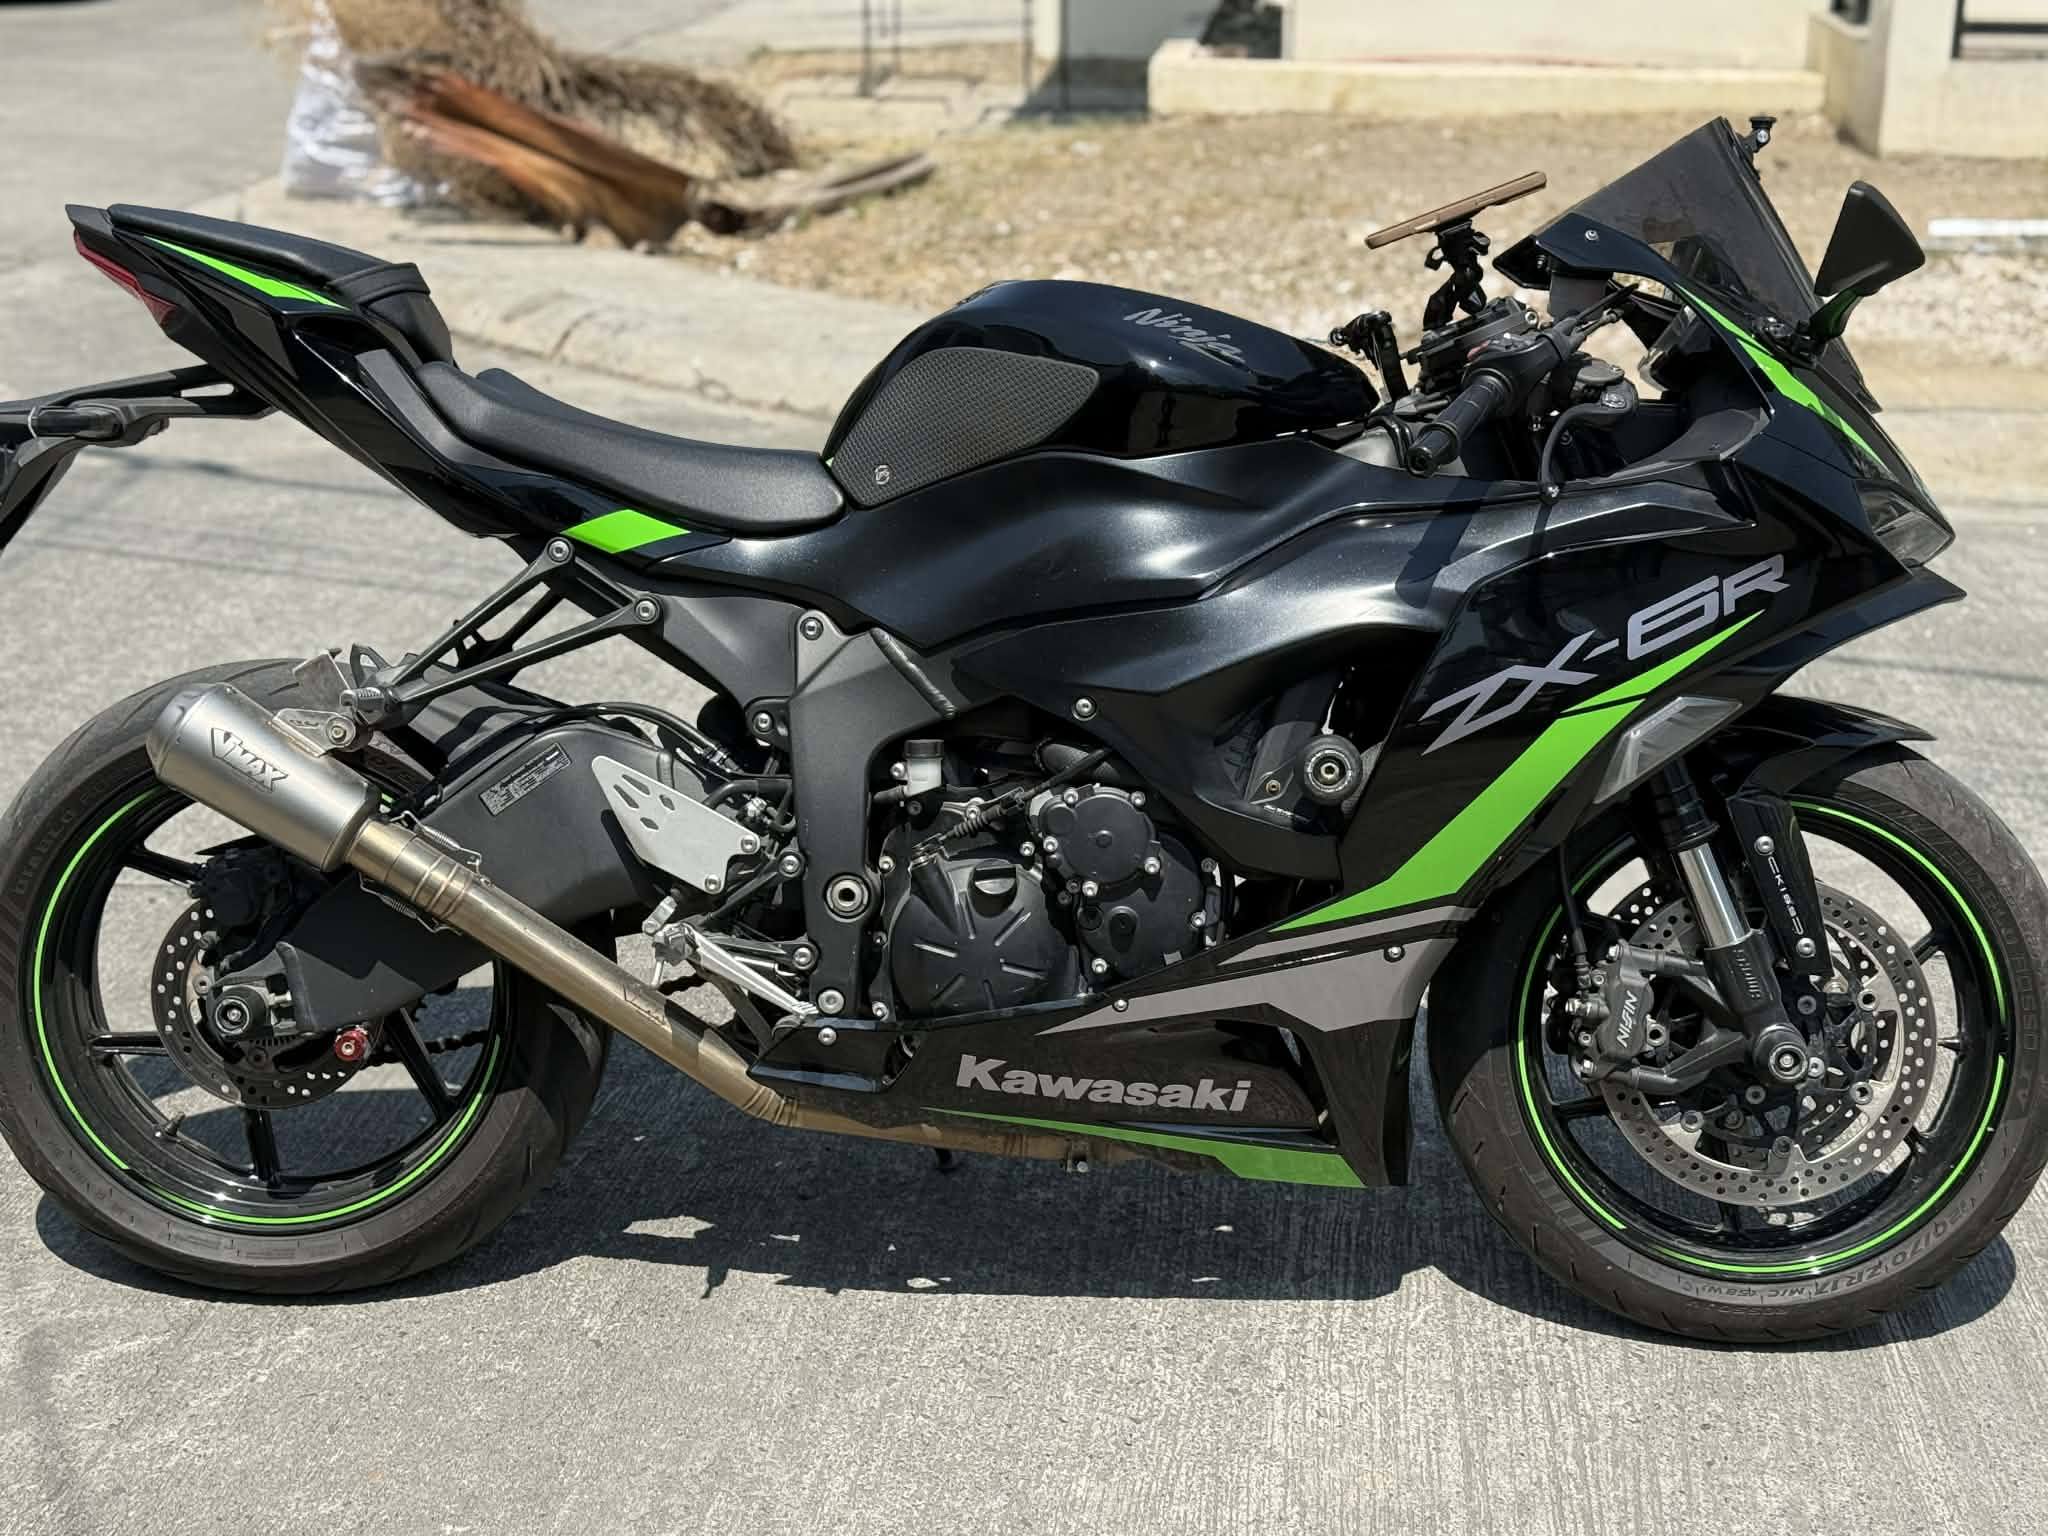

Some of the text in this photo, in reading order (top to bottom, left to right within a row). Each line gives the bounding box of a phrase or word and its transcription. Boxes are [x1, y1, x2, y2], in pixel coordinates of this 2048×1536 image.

[1123, 308, 1246, 367] Ninja
[1419, 553, 1791, 757] ZX-6R
[1616, 990, 1638, 1048] NISSIN
[956, 1054, 1252, 1112] Kawasaki
